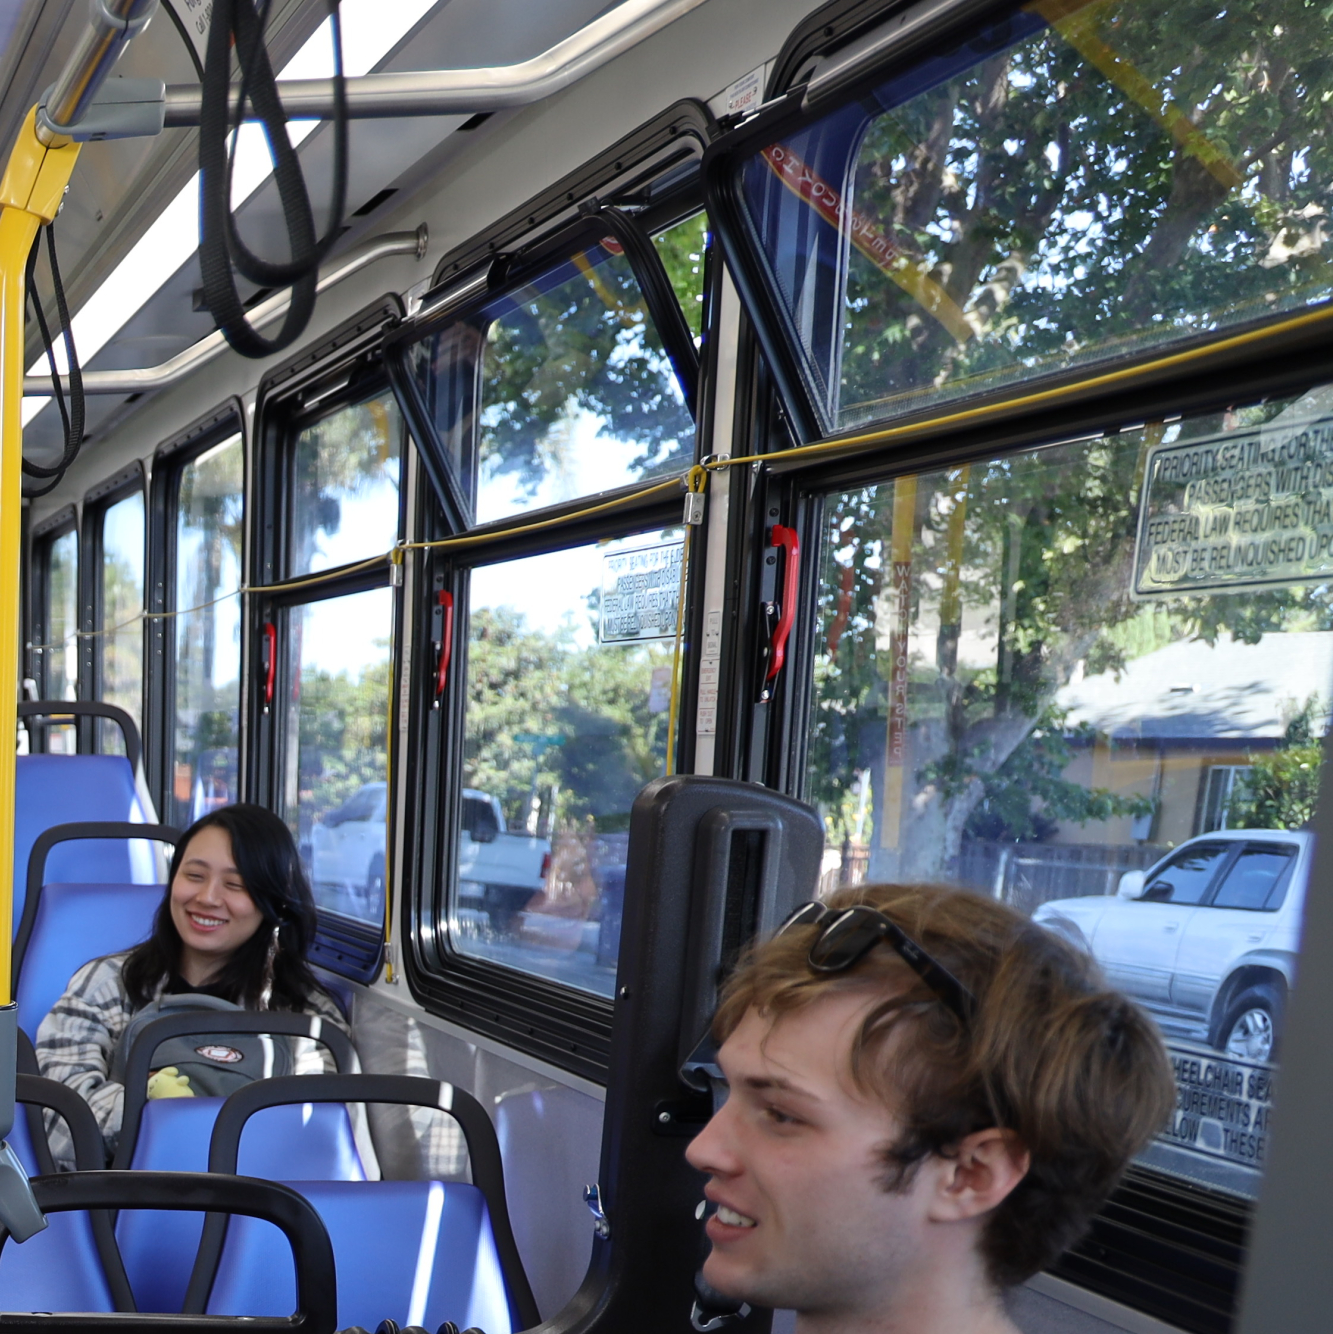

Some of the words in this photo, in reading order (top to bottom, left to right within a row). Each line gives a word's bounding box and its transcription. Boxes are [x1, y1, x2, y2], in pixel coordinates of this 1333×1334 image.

[1162, 449, 1216, 478] PRIORITY
[1188, 469, 1272, 504] PASSENGERS
[1276, 465, 1309, 491] WITH
[1148, 514, 1200, 546] FEDERAL
[1203, 511, 1231, 539] LAW
[1234, 501, 1300, 534] REQUIRES
[1304, 499, 1333, 525] THA
[1155, 550, 1189, 575] MUST
[1191, 548, 1206, 572] BE
[1209, 535, 1306, 570] RELINQUISHED
[1174, 1058, 1243, 1097] HEELCHAIR
[1177, 1087, 1250, 1127] UREMENTS
[1223, 1127, 1265, 1160] THESE
